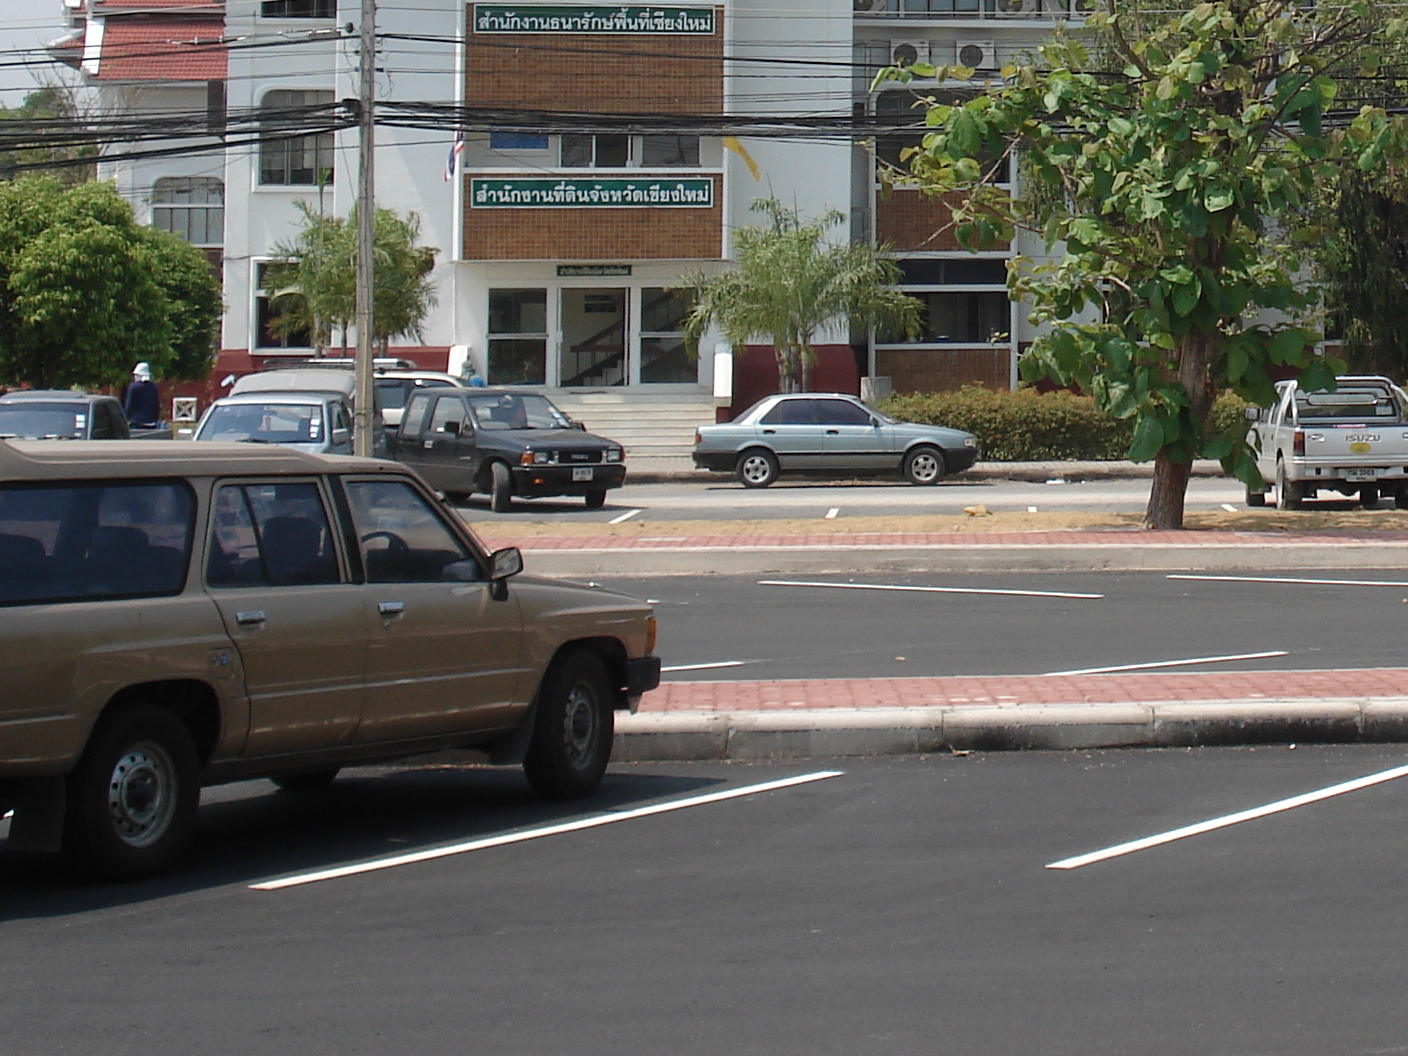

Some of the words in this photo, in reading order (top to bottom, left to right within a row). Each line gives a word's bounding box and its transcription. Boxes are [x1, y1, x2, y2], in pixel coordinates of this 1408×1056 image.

[477, 7, 712, 31] สำนักงานธนารักษ์พื้นที่เชียงใหม่
[475, 181, 709, 203] สำนักงานที่ดินจังหวัดเชียงใหม่
[1345, 434, 1381, 442] ISUZU
